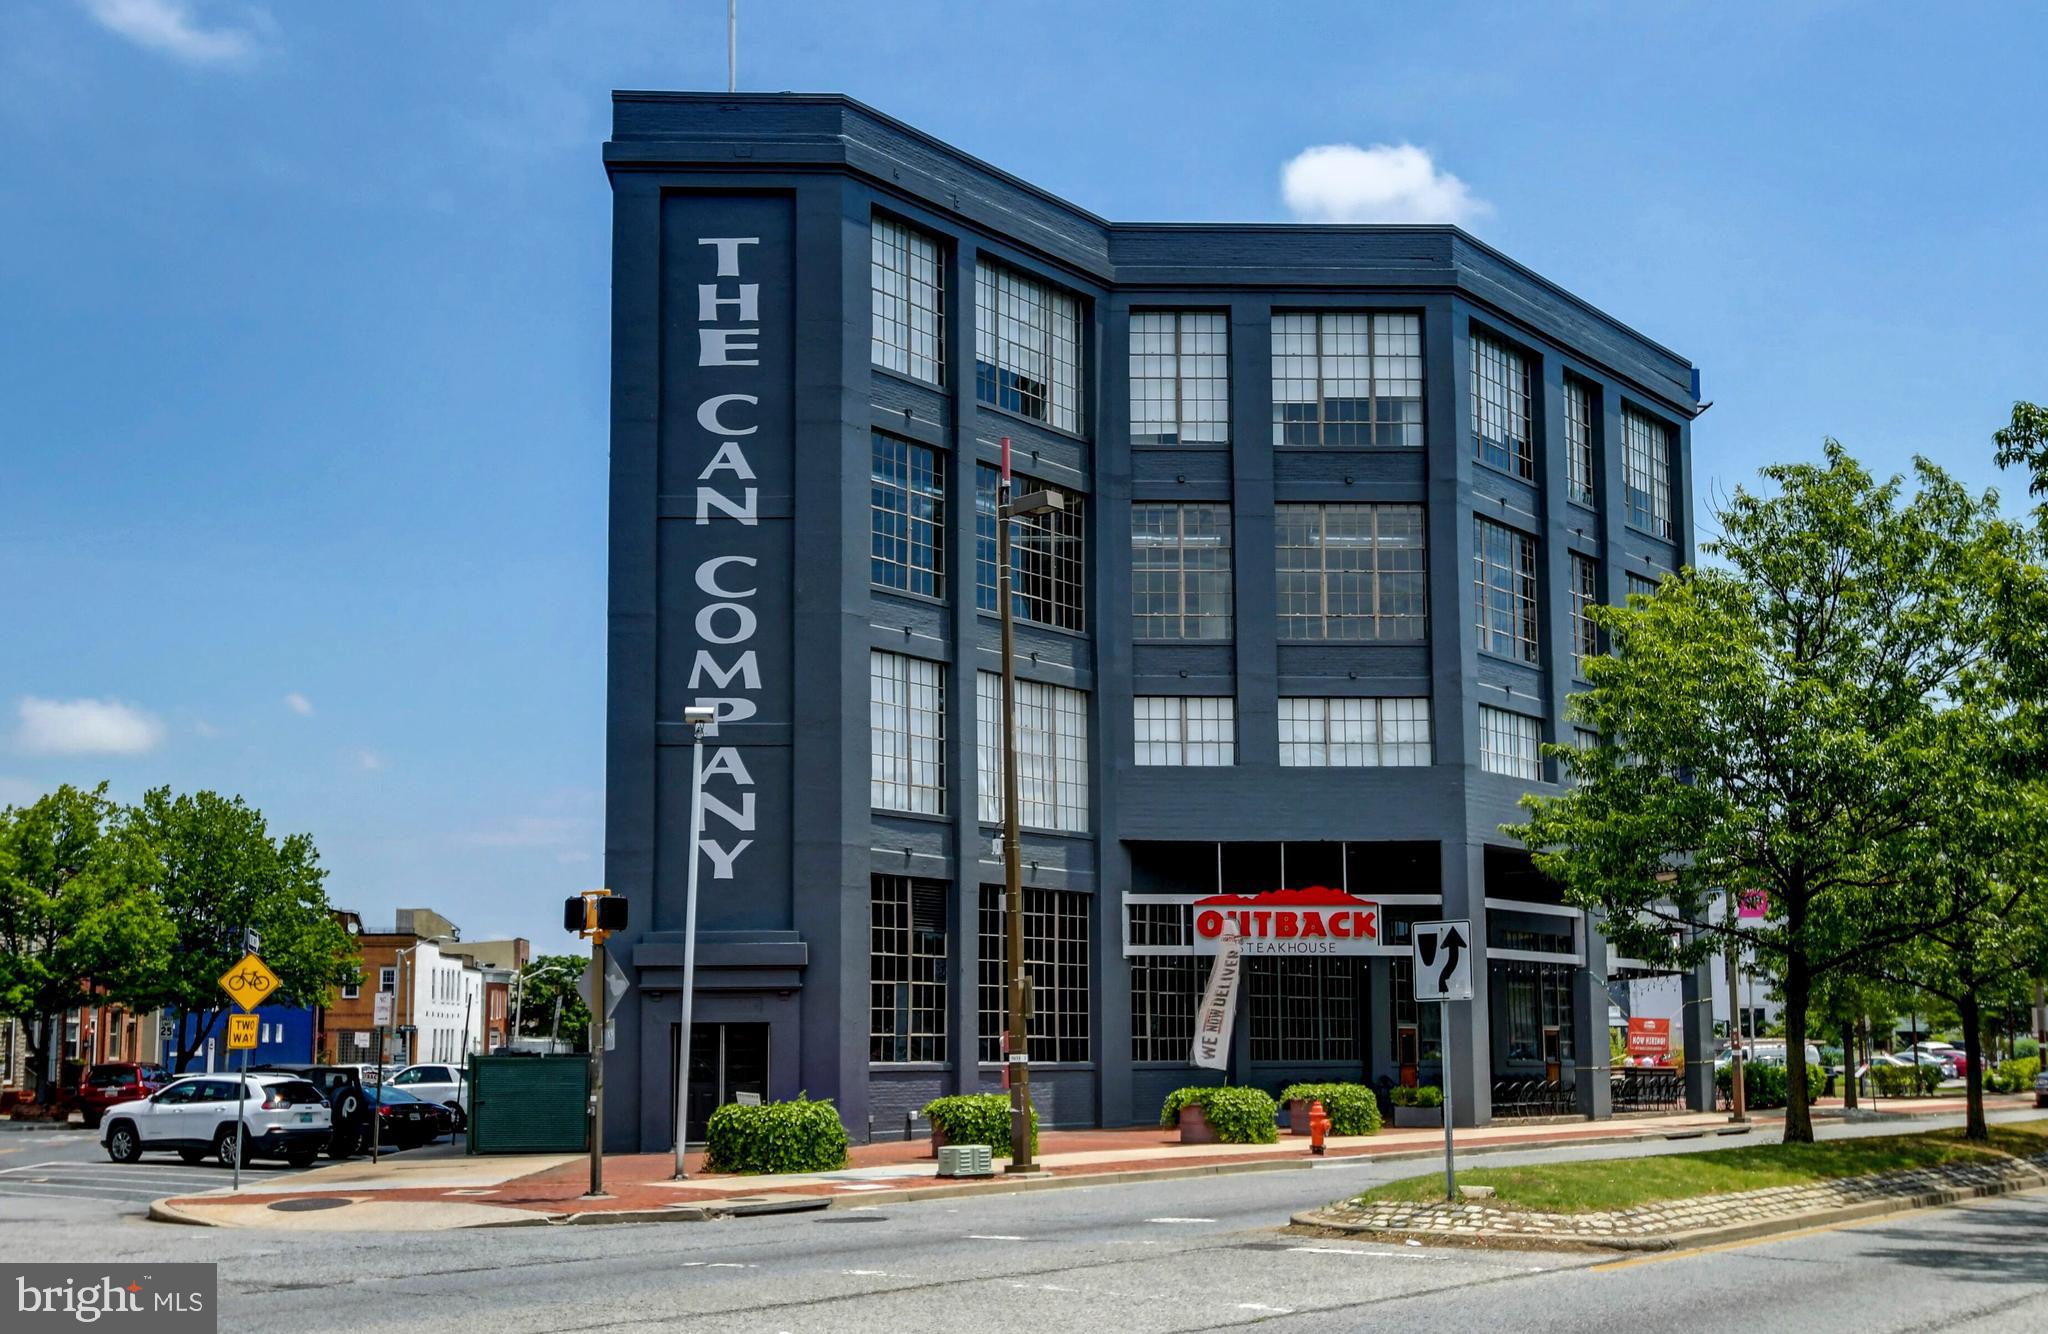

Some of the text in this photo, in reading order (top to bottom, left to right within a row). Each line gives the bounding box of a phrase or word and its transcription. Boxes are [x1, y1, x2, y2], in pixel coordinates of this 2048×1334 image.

[687, 237, 763, 880] THE CAN COMPANY
[1216, 949, 1239, 1008] DELIVER
[160, 1026, 172, 1037] 25
[235, 1020, 255, 1030] TWO
[1206, 1008, 1224, 1032] NOW
[233, 1033, 254, 1042] WAY
[1201, 1035, 1218, 1060] WE
